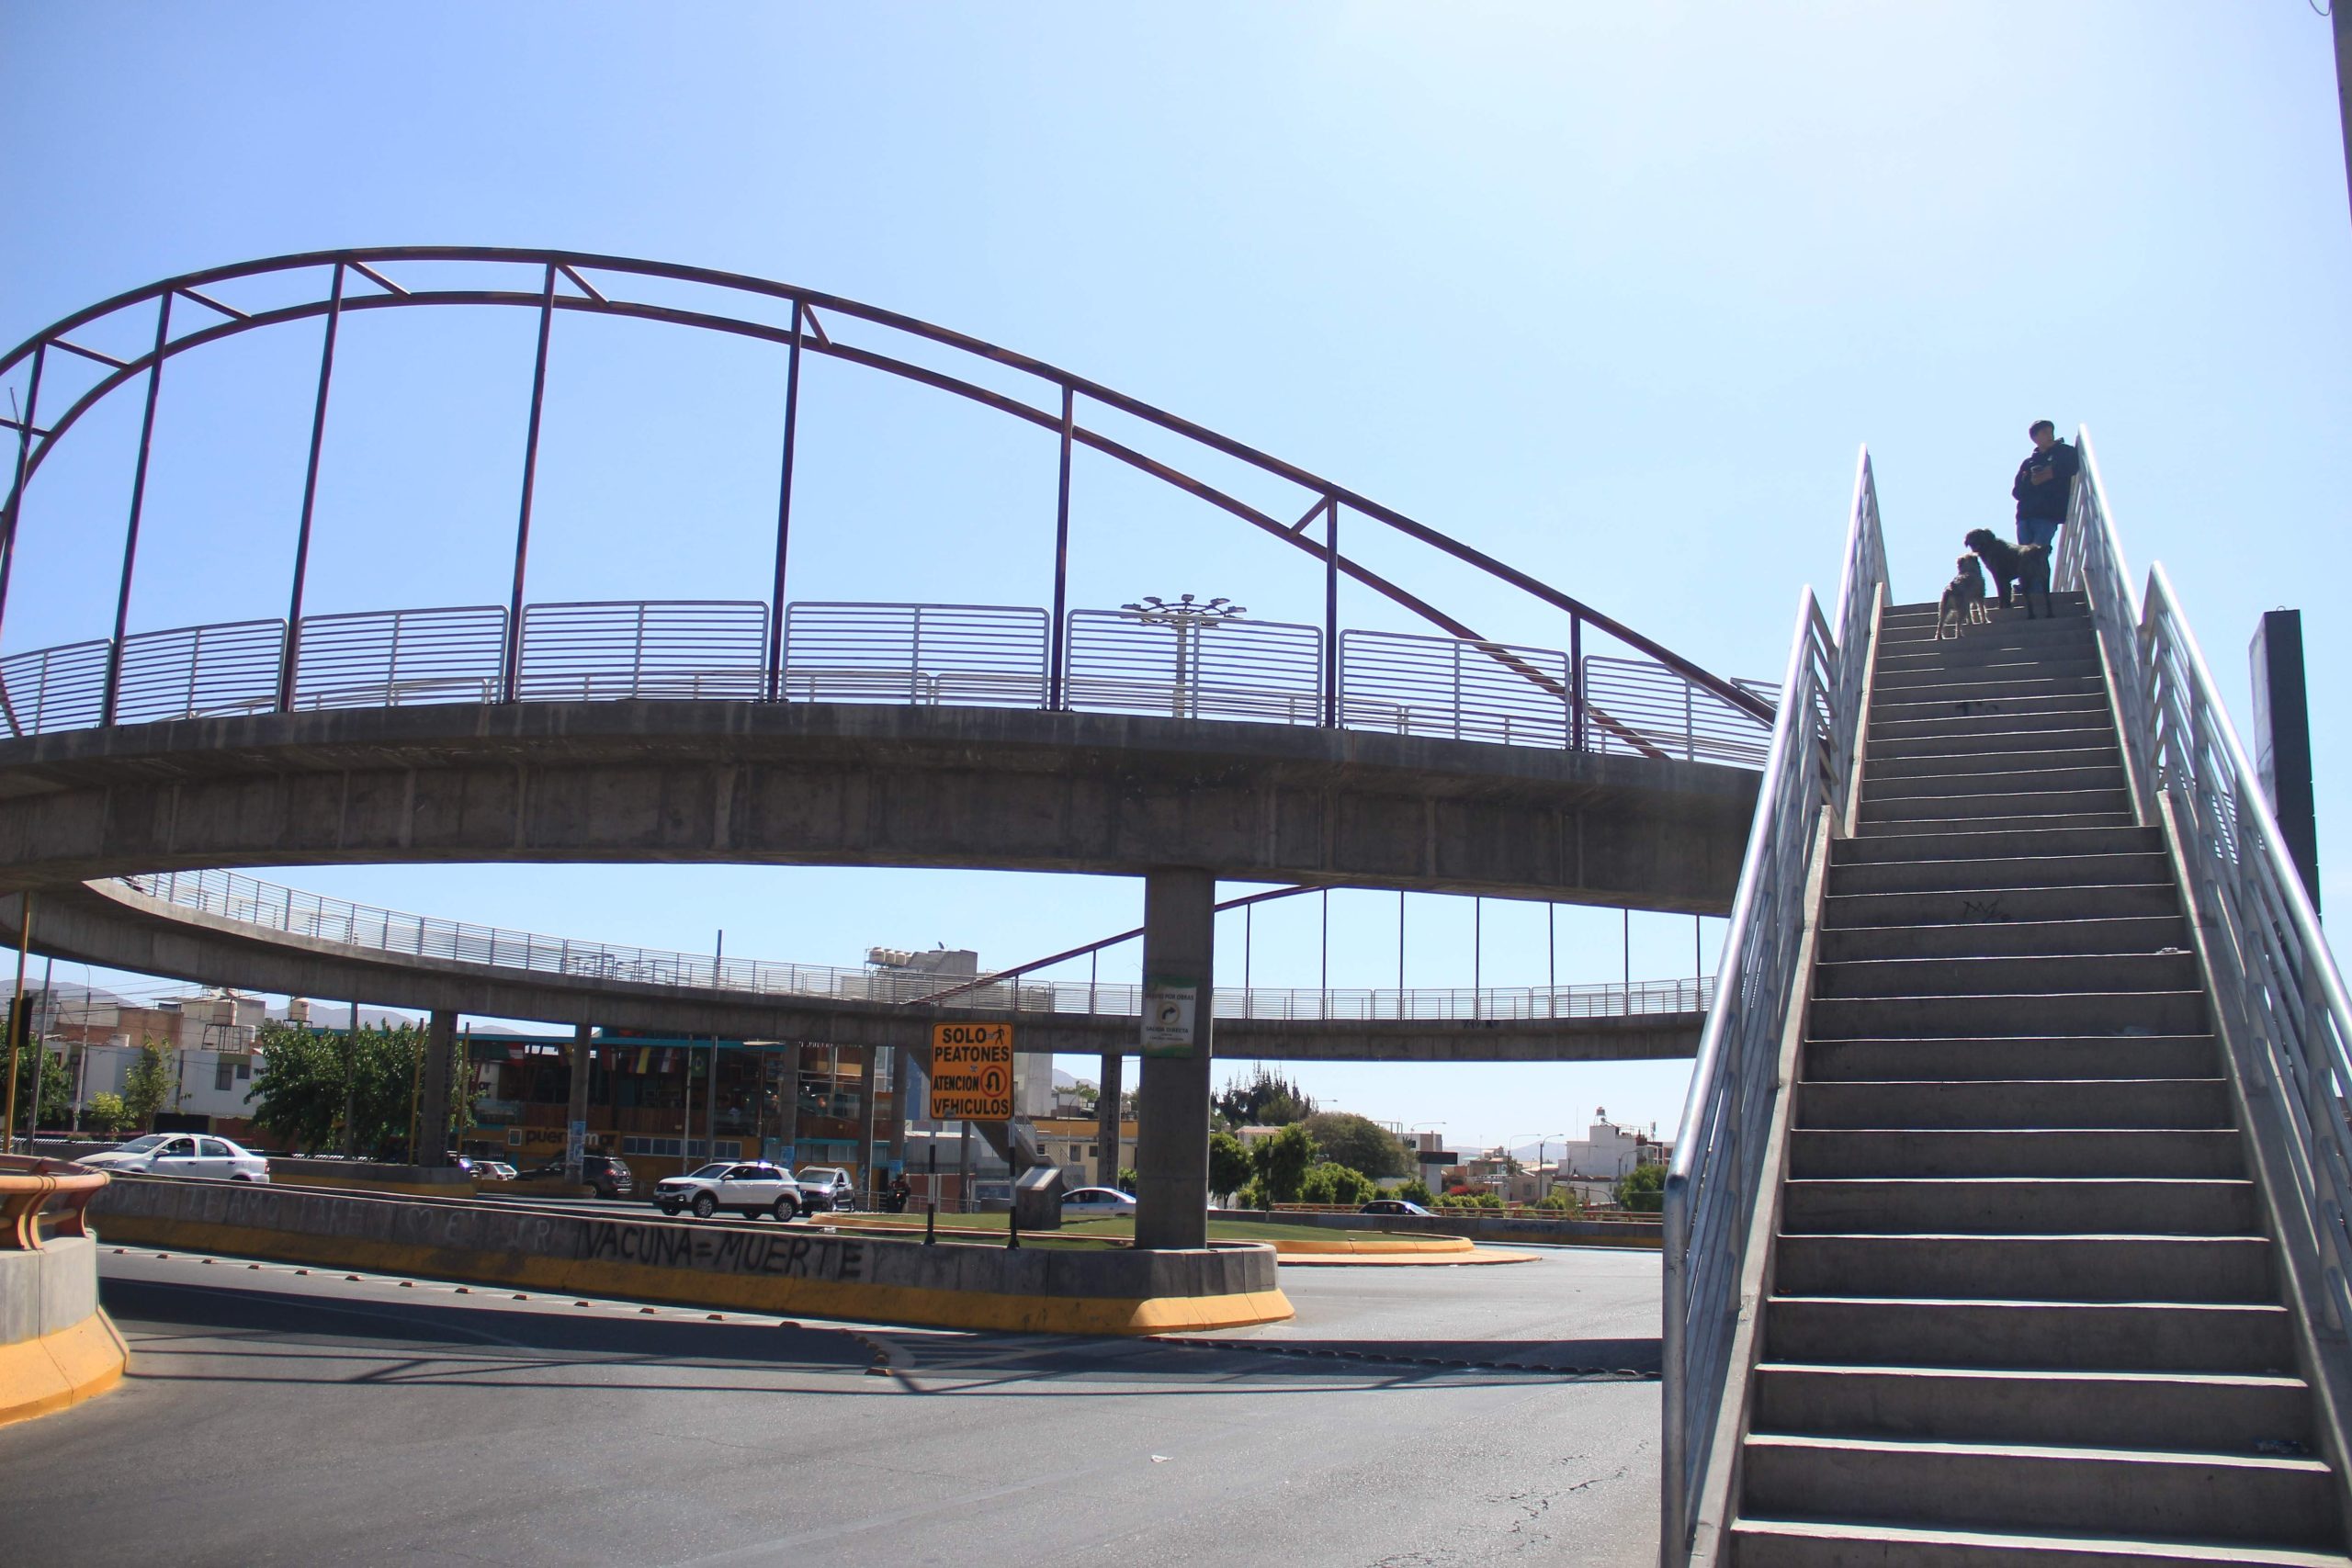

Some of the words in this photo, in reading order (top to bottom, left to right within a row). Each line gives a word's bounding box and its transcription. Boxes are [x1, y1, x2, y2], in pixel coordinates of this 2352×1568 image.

[942, 1027, 987, 1043] SOLO
[933, 1045, 1010, 1062] PEATONES
[933, 1075, 980, 1091] ATENCION
[933, 1098, 1009, 1115] VEHICULOS
